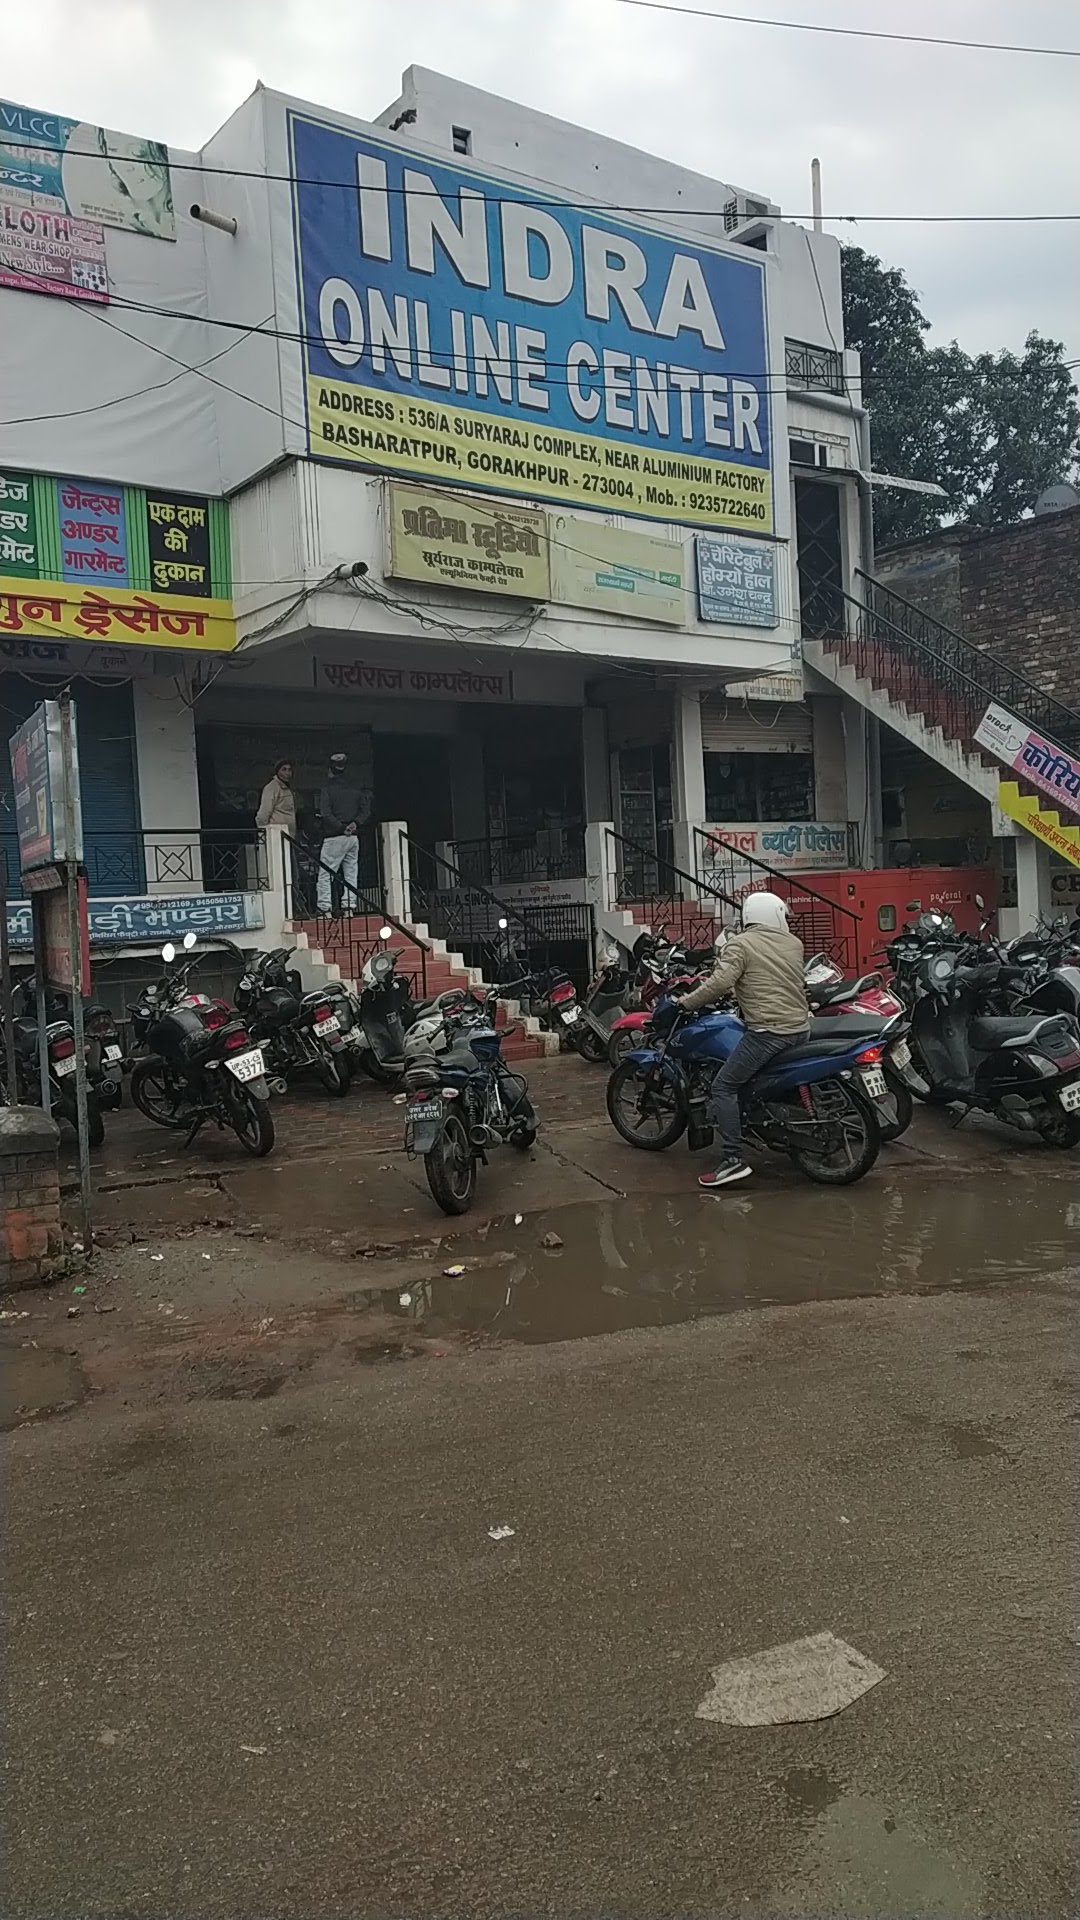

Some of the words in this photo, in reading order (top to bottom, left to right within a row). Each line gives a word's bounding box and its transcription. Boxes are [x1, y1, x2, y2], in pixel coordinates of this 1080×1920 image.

[1, 107, 56, 139] VLCC
[48, 244, 71, 259] SHOP
[355, 152, 727, 351] INDRA
[318, 276, 551, 413] ONLINE
[565, 339, 764, 455] CENTER
[319, 388, 394, 421] ADDRESS
[408, 407, 450, 433] 536/A
[454, 416, 529, 450] SURYARAJ
[533, 434, 602, 468] COMPLEX,
[605, 449, 640, 472] NEAR
[642, 457, 712, 485] ALUMINIUM
[715, 470, 765, 494] FACTORY
[321, 421, 462, 470] BASHARATPUR,
[467, 450, 570, 487] GORAKHPUR
[582, 473, 634, 499] 273004
[646, 486, 678, 507] Mob.
[690, 493, 766, 520] 9235722640
[61, 484, 122, 518] जेन्ट्स
[61, 519, 120, 545] अण्डर
[401, 505, 468, 545] प्रतिमा
[163, 527, 189, 553] की
[64, 547, 126, 574] गारमेन्ट
[421, 550, 465, 568] सूर्यराज
[153, 560, 206, 588] दुकान
[743, 572, 773, 590] हाल
[74, 590, 210, 637] ड्रेसेज
[985, 713, 1006, 730] DTDC
[238, 1062, 262, 1080] 5377
